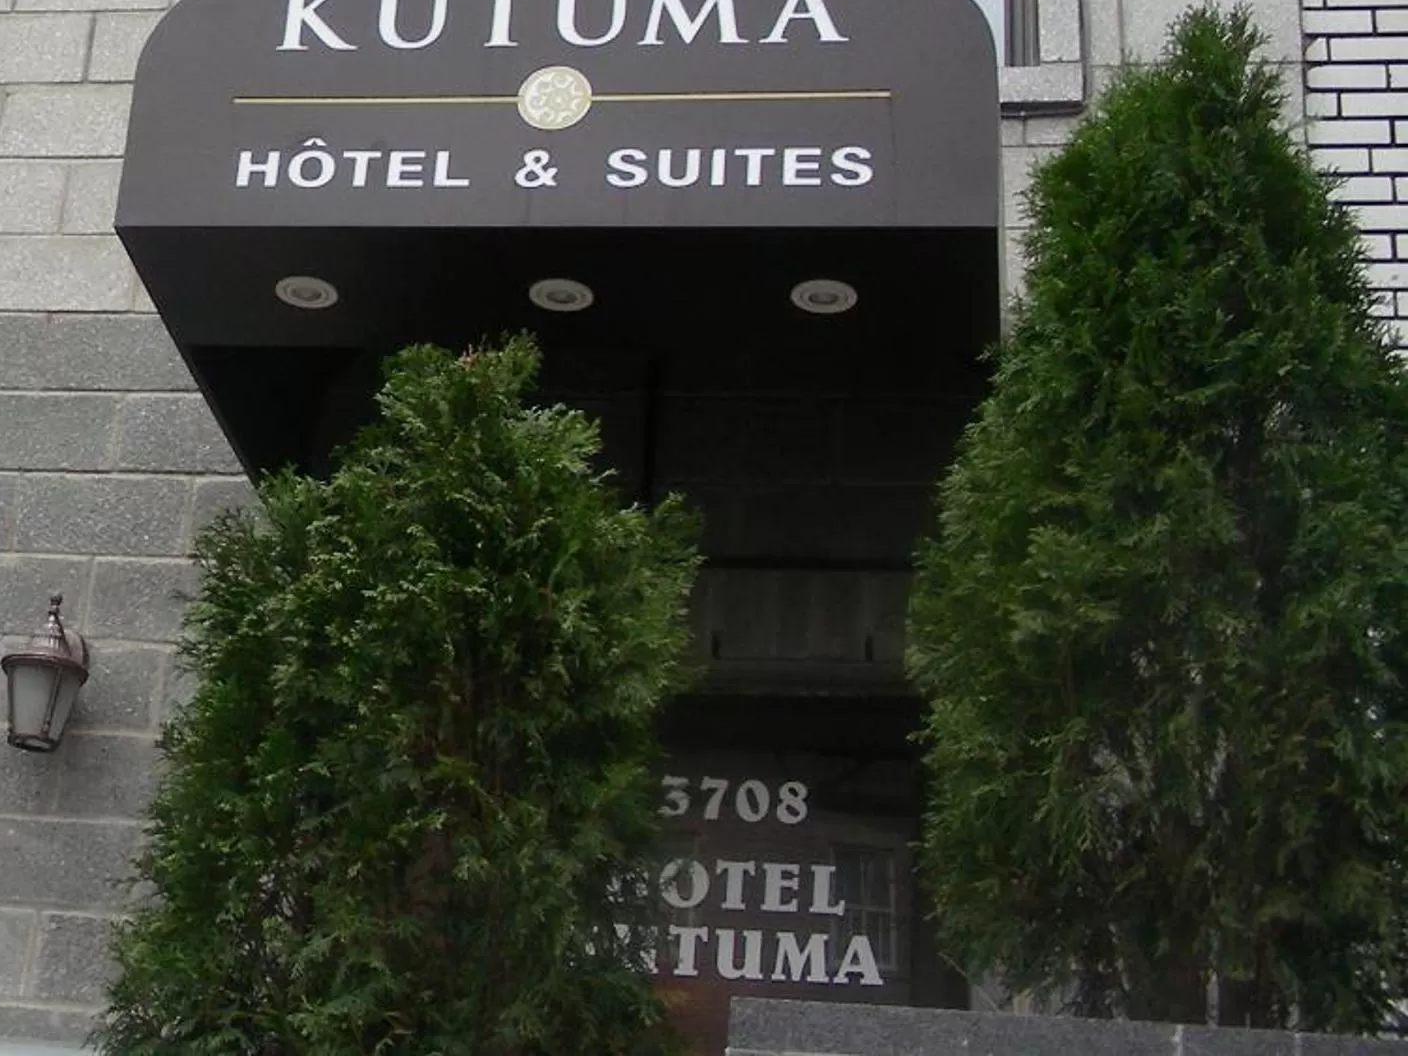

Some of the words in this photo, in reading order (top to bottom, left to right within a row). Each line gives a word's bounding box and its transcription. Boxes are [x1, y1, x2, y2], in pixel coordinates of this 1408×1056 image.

[235, 138, 470, 188] HÔTEL
[514, 149, 560, 188] &
[606, 146, 875, 187] SUITES
[658, 775, 809, 825] 3708
